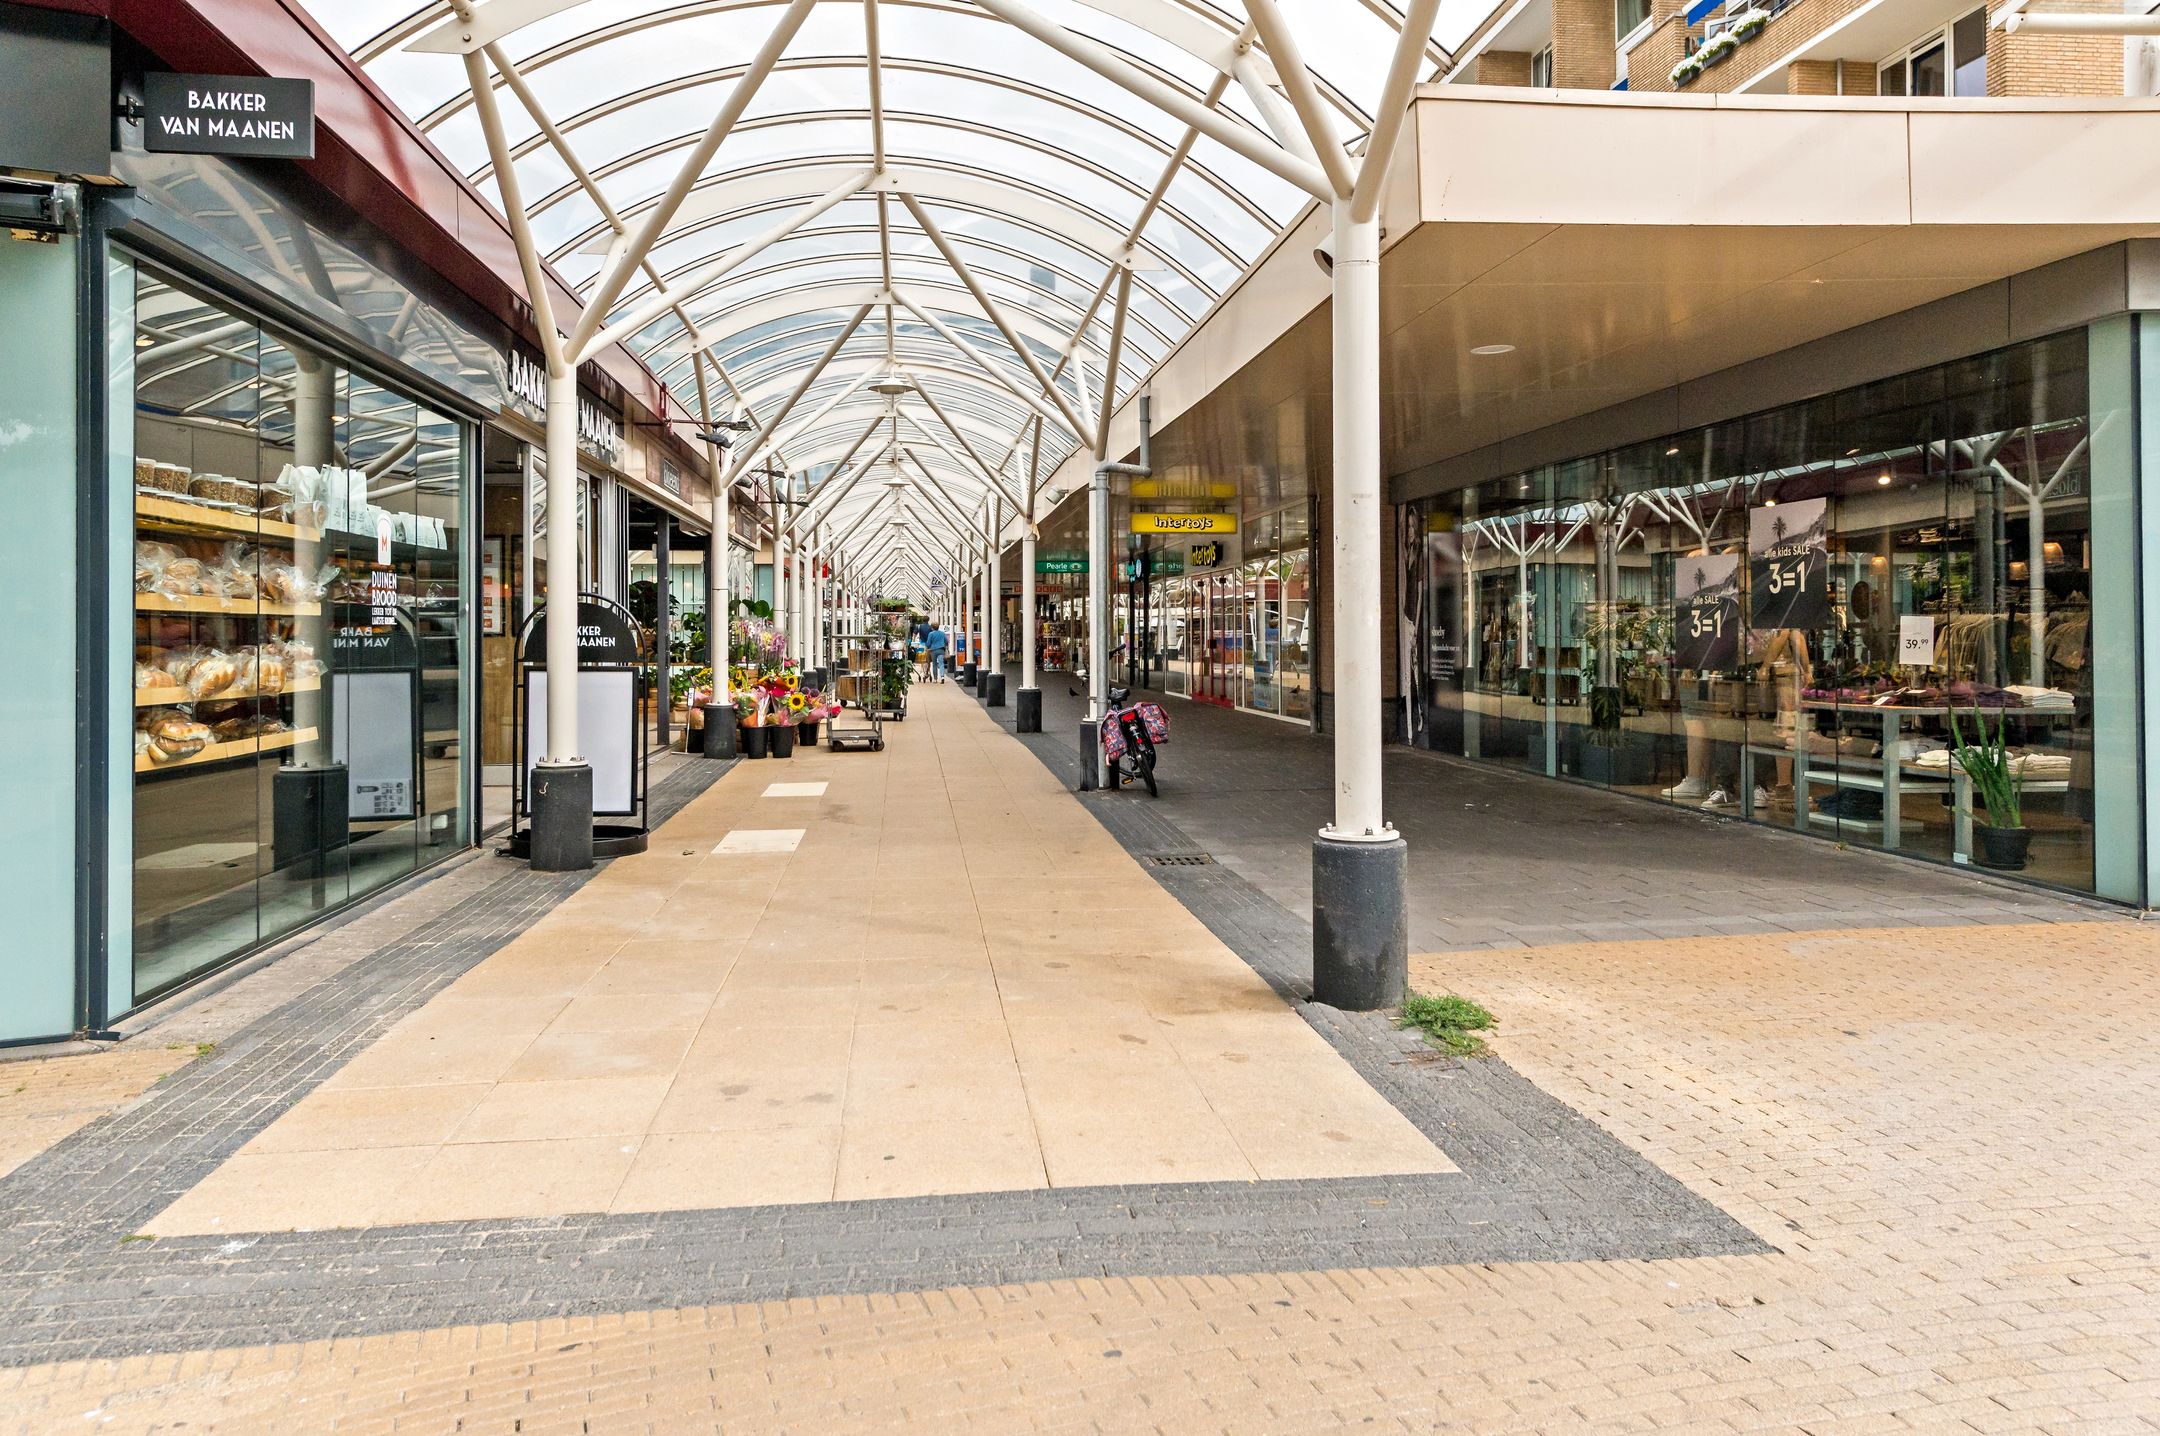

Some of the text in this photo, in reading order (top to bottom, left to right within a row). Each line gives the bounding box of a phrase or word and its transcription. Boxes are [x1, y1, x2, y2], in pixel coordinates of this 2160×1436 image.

[188, 90, 266, 112] BAKKER
[159, 115, 294, 140] VAN MAANEN
[512, 349, 616, 452] BAKK MAANEN
[1154, 516, 1213, 530] Intertoys
[1764, 544, 1810, 558] alle kids SALE
[1046, 562, 1068, 570] Pearle
[371, 570, 397, 589] DUINEN
[1768, 561, 1806, 594] 3=1
[371, 589, 397, 606] BROOD
[1704, 595, 1719, 605] SALE
[577, 625, 601, 636] KKER
[1690, 609, 1722, 638] 3=1
